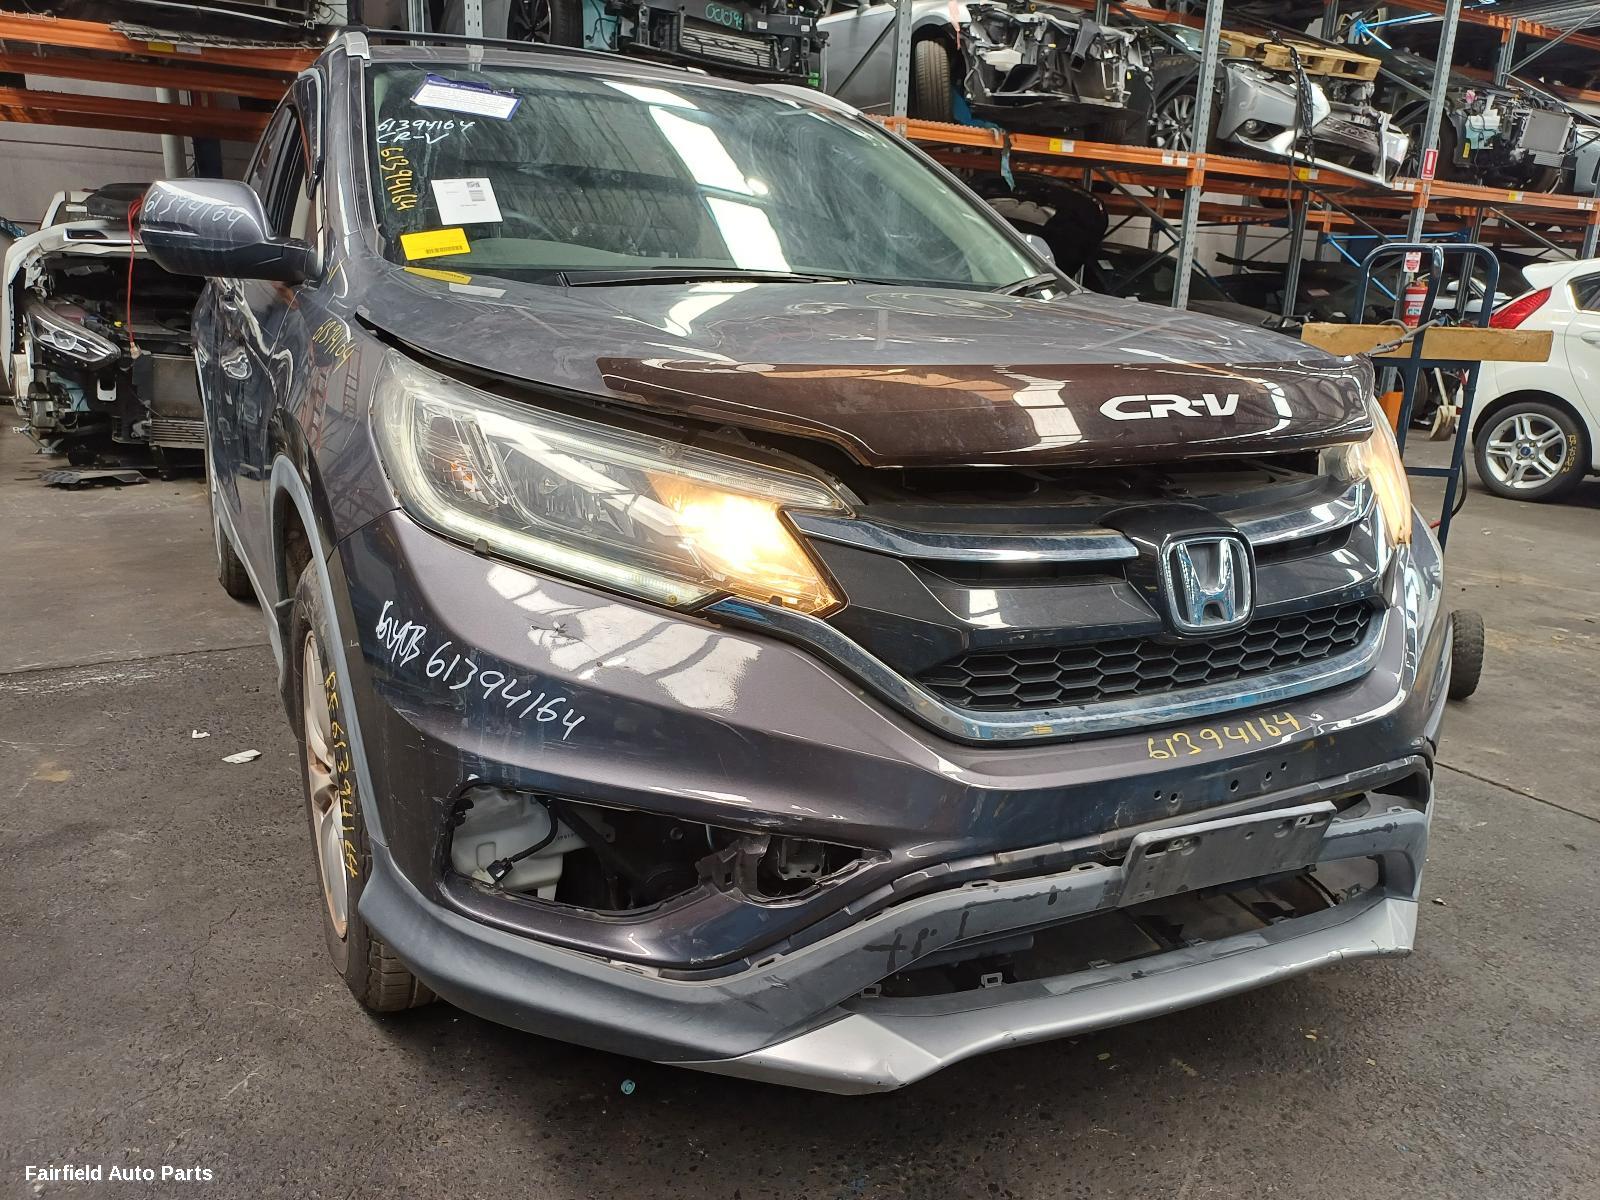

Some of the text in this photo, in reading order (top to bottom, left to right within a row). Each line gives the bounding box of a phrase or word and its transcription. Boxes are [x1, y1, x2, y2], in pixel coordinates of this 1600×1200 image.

[376, 131, 449, 144] CR-V
[377, 118, 475, 131] 61394164
[380, 147, 417, 211] 61394164
[1100, 394, 1239, 420] CR-V
[426, 641, 586, 741] 61394164
[1148, 712, 1300, 760] 61394164
